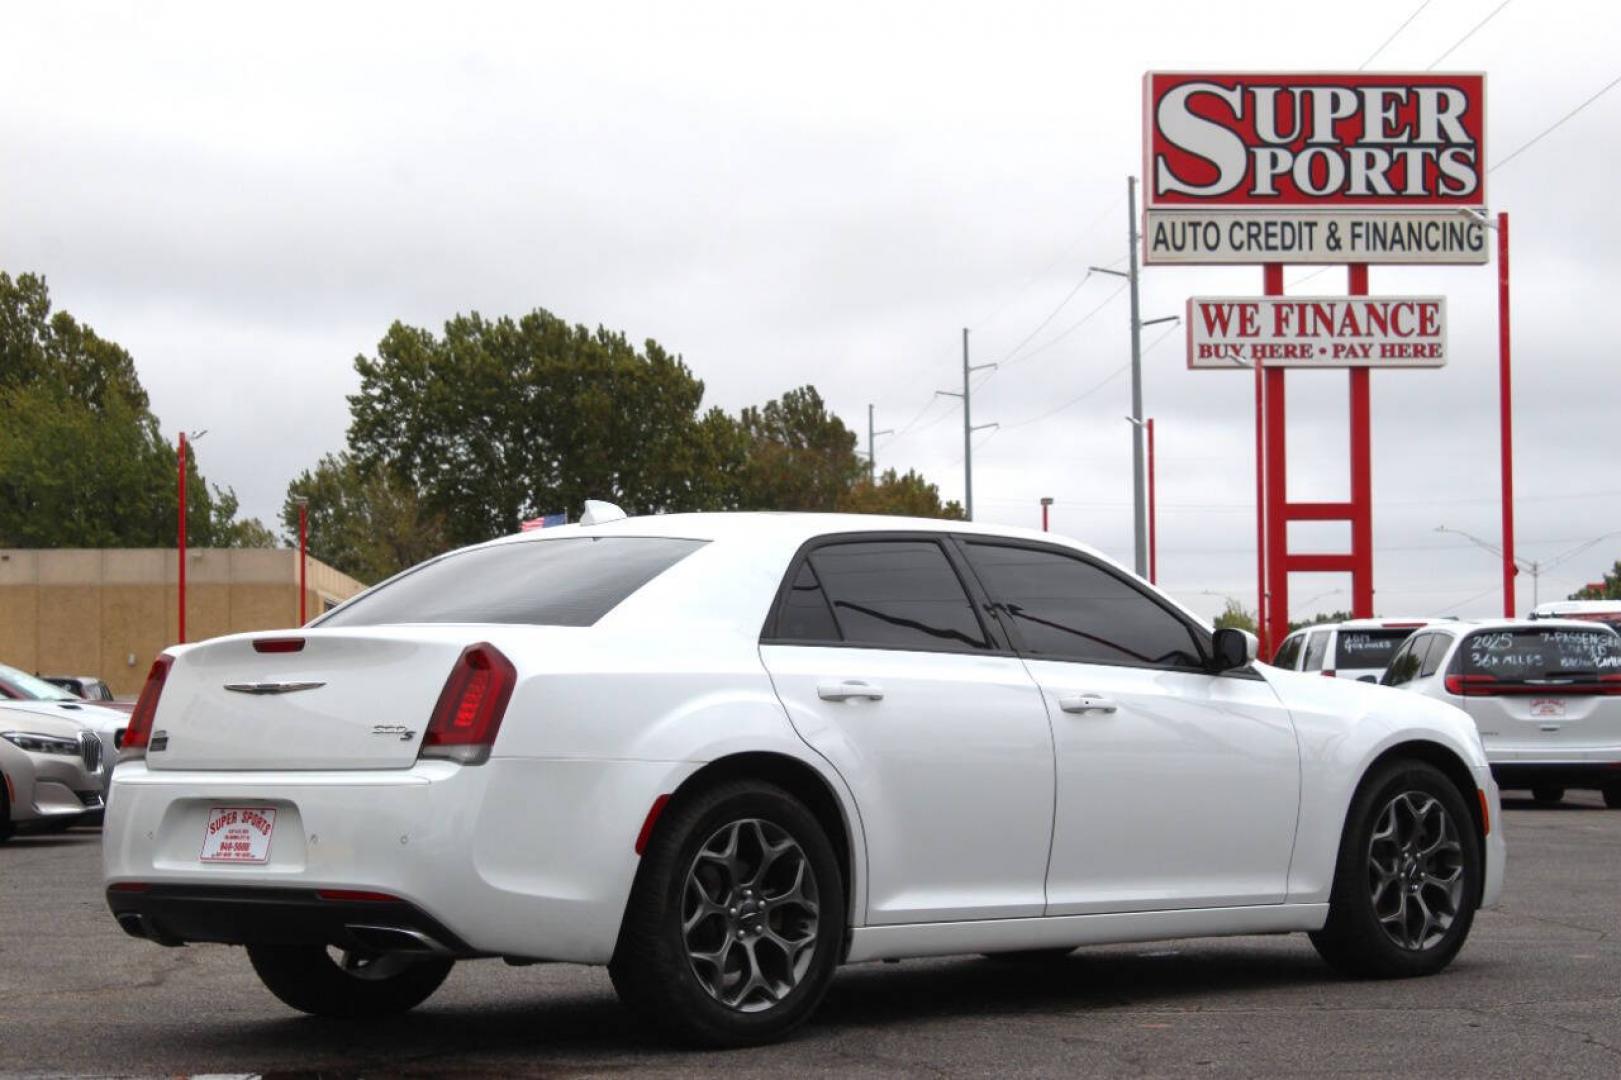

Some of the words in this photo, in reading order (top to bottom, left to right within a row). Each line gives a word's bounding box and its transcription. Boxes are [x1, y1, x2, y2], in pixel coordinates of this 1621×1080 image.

[1153, 222, 1221, 251] AUTO
[1229, 222, 1318, 251] CREDIT
[1326, 221, 1342, 251] &
[1351, 221, 1484, 252] FINANCING
[1199, 303, 1261, 338] WE
[1272, 303, 1441, 338] FINANCE
[1198, 343, 1245, 359] BUY
[1250, 343, 1314, 359] HERE
[1332, 343, 1374, 359] PAY
[1379, 343, 1443, 359] HERE
[1472, 632, 1513, 650] 2025
[1502, 654, 1544, 667] MILES
[210, 811, 237, 835] SUPER
[242, 811, 271, 836] SPORTS
